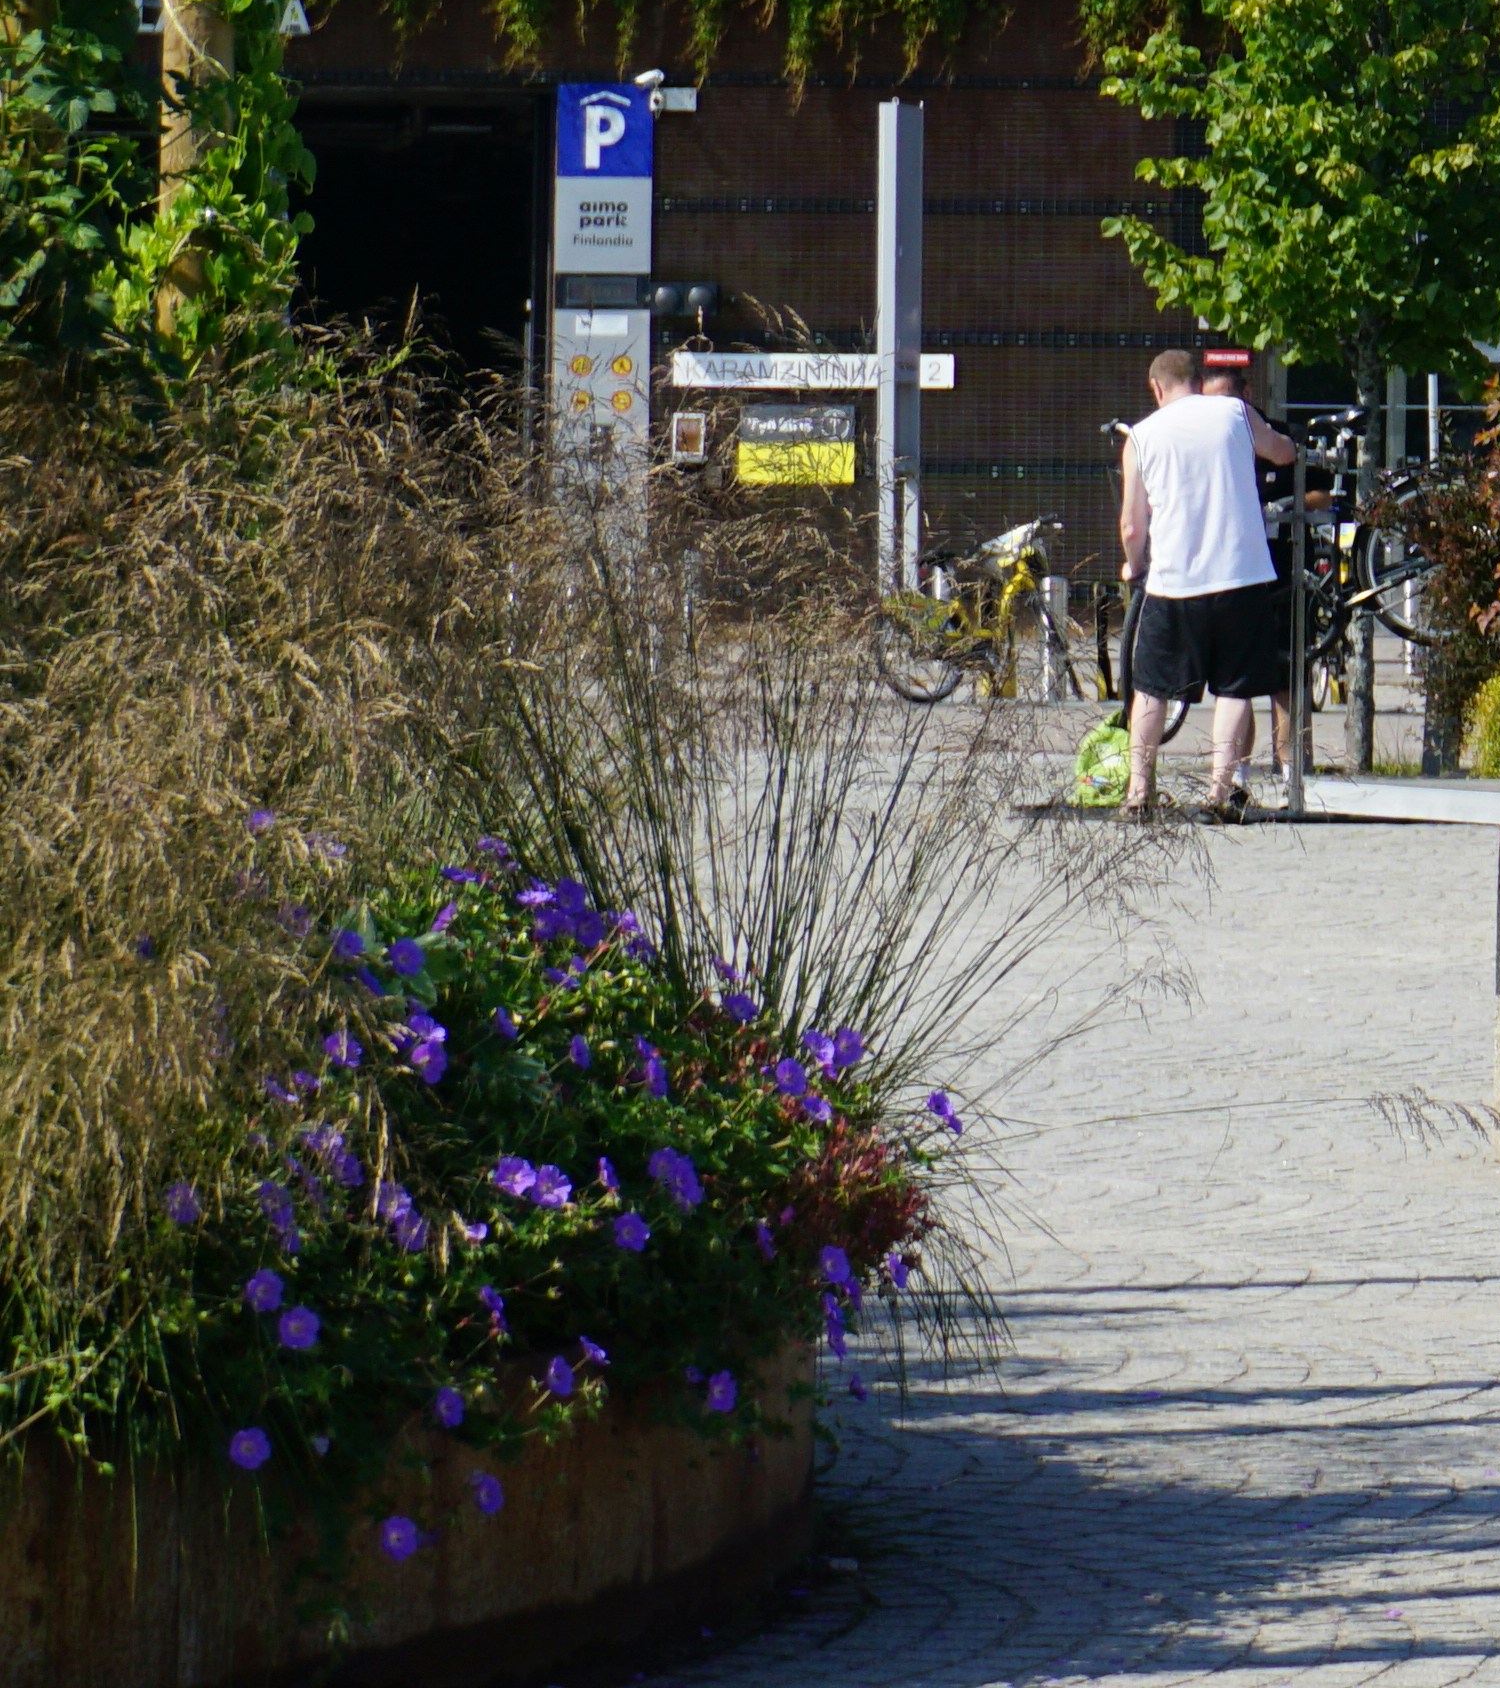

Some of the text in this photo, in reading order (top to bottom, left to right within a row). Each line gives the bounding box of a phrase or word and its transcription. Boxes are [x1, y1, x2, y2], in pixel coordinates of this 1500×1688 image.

[585, 104, 626, 169] P
[579, 201, 628, 213] aimo
[579, 213, 628, 229] park
[573, 234, 633, 246] Finlandia
[928, 362, 942, 382] 2
